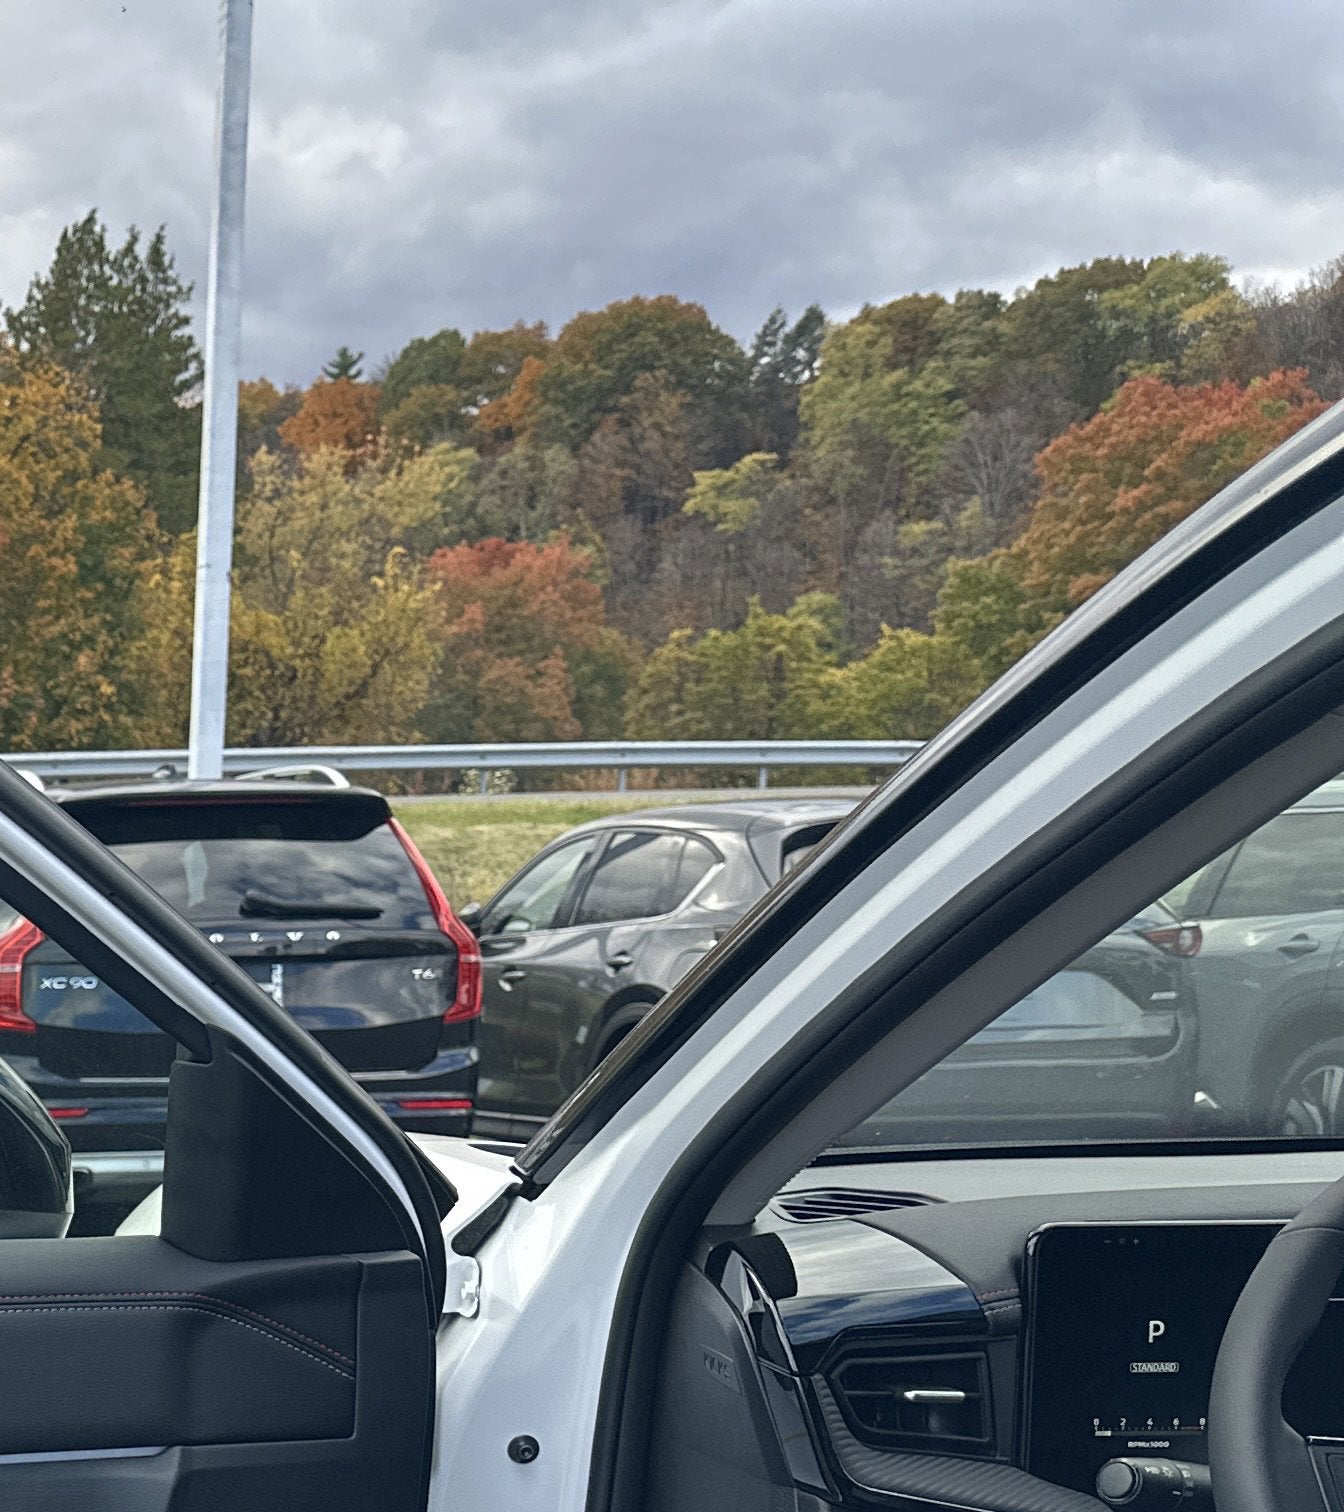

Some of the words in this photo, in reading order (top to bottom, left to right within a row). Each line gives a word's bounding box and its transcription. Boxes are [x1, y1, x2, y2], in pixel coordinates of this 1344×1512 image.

[208, 930, 341, 943] OLVO
[1148, 1319, 1165, 1343] P
[1131, 1362, 1178, 1373] STANDARD
[1120, 1418, 1127, 1426] 2
[1147, 1418, 1153, 1426] 4
